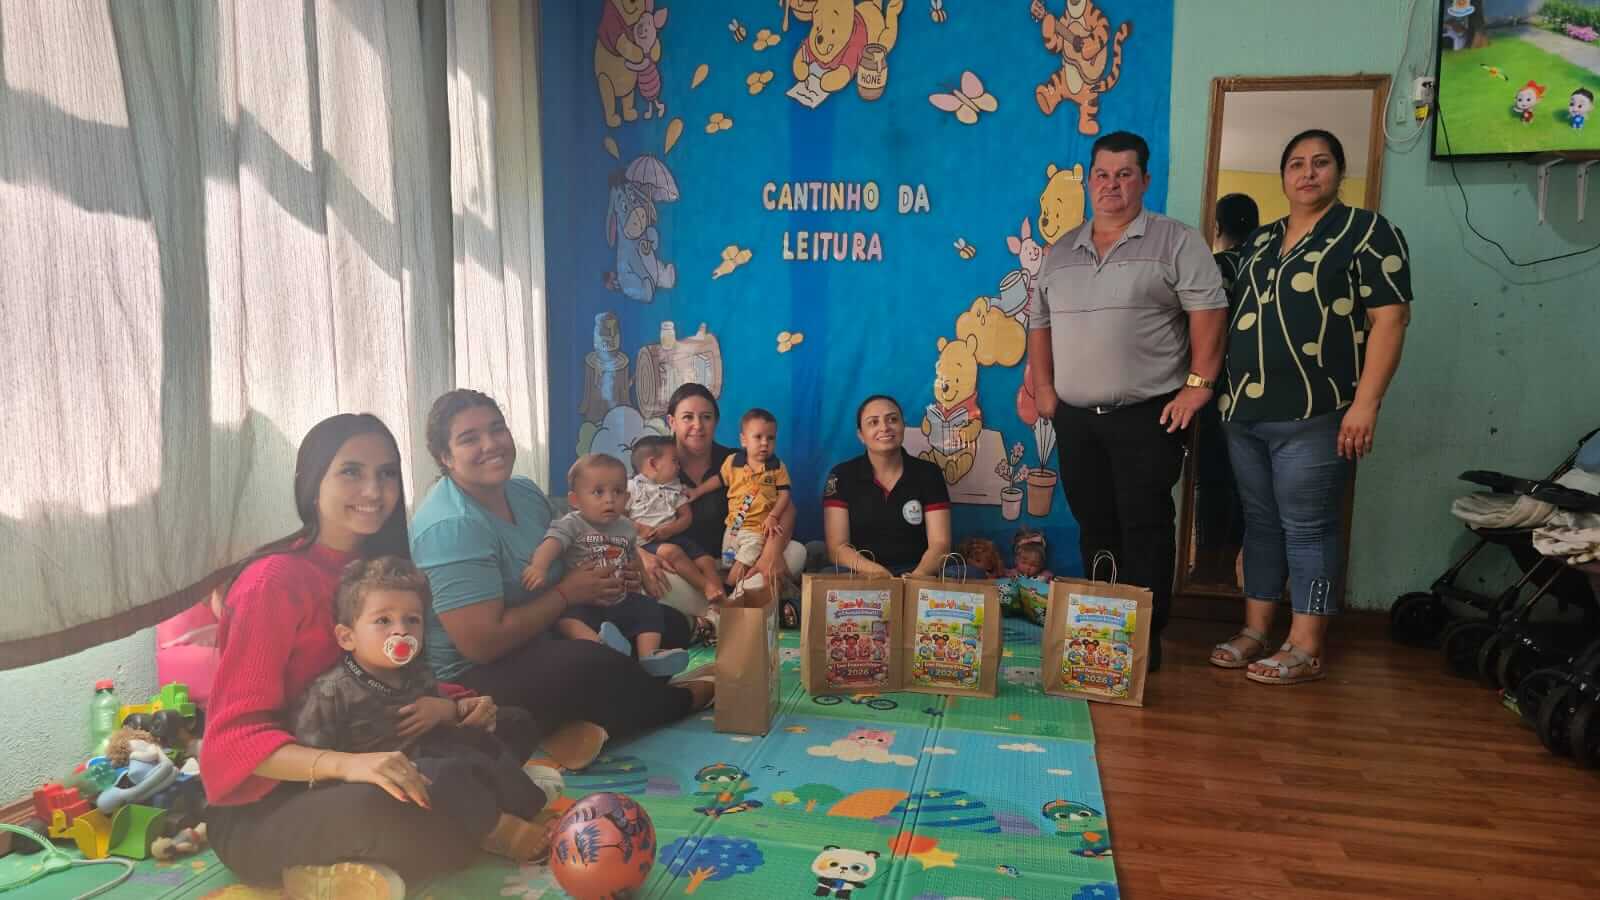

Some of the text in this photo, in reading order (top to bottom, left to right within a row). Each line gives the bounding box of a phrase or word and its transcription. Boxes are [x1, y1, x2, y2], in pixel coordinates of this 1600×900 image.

[762, 181, 931, 214] CANTINHO DA
[782, 231, 883, 262] LEITURA
